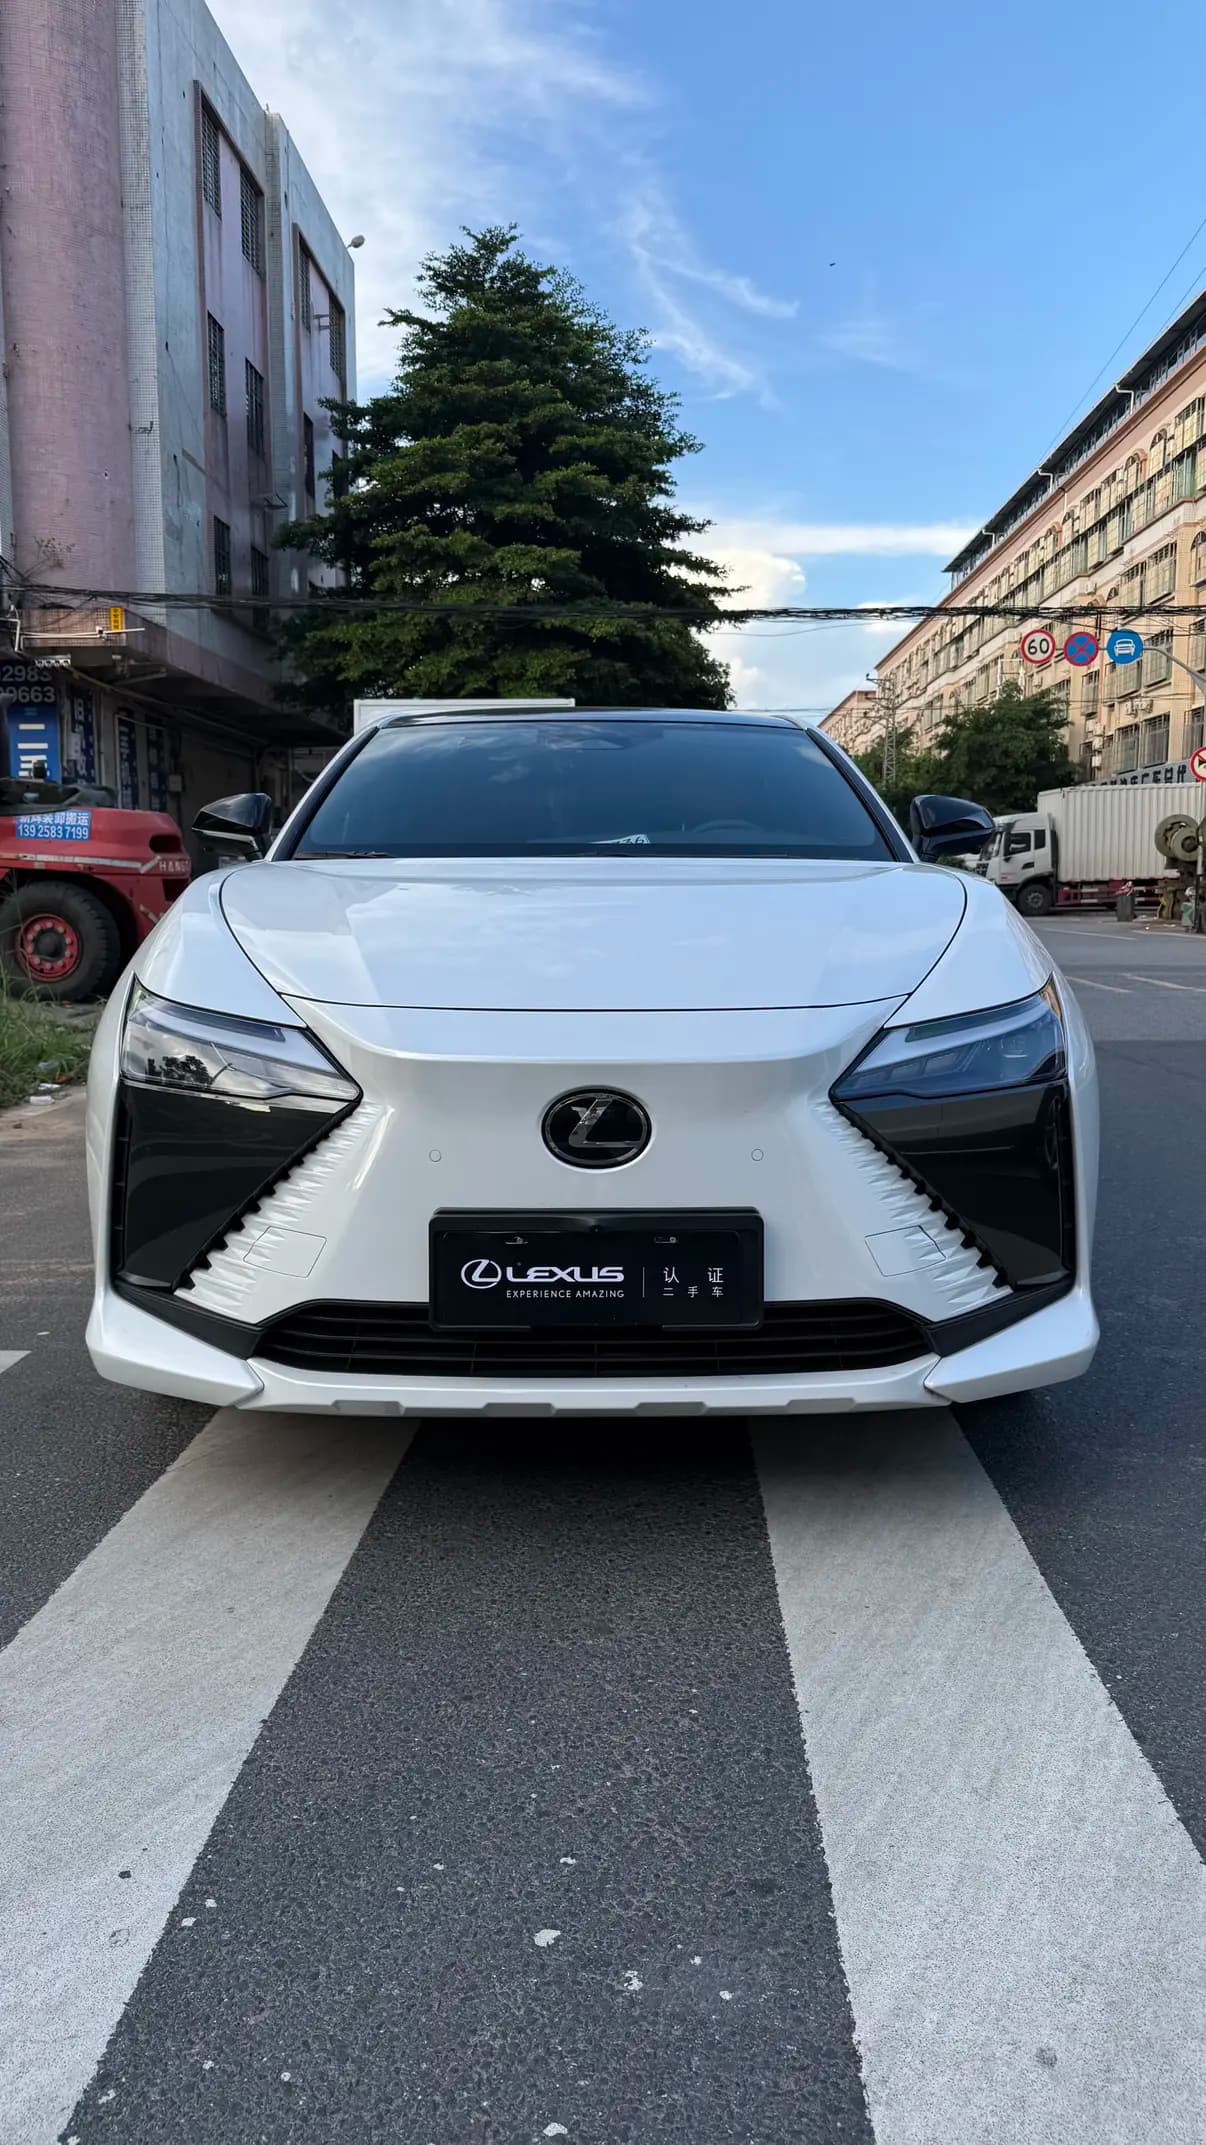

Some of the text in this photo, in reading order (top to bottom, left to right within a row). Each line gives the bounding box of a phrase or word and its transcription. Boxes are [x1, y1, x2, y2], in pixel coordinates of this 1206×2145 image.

[1028, 638, 1050, 655] 60
[17, 824, 89, 840] 139 2583 7199
[506, 1266, 625, 1283] LEXUS
[663, 1266, 725, 1284] 认证
[506, 1289, 625, 1299] EXPERIENCE AMAZING
[663, 1286, 725, 1298] 二手车
